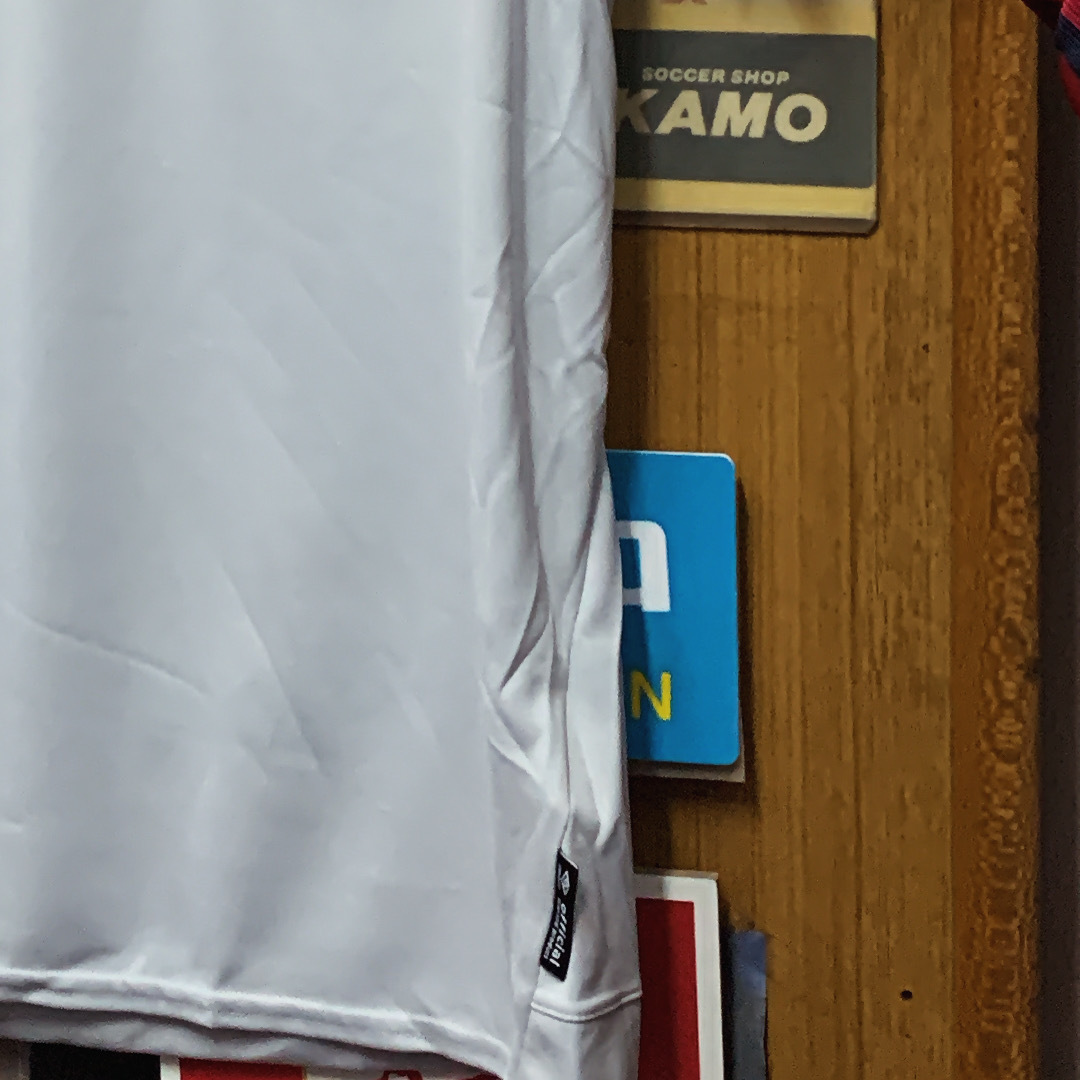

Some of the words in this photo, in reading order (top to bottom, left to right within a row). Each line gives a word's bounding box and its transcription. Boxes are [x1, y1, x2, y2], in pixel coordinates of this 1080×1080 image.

[642, 67, 725, 84] SOCCER
[731, 69, 790, 85] SHOP
[616, 88, 828, 143] KAMO
